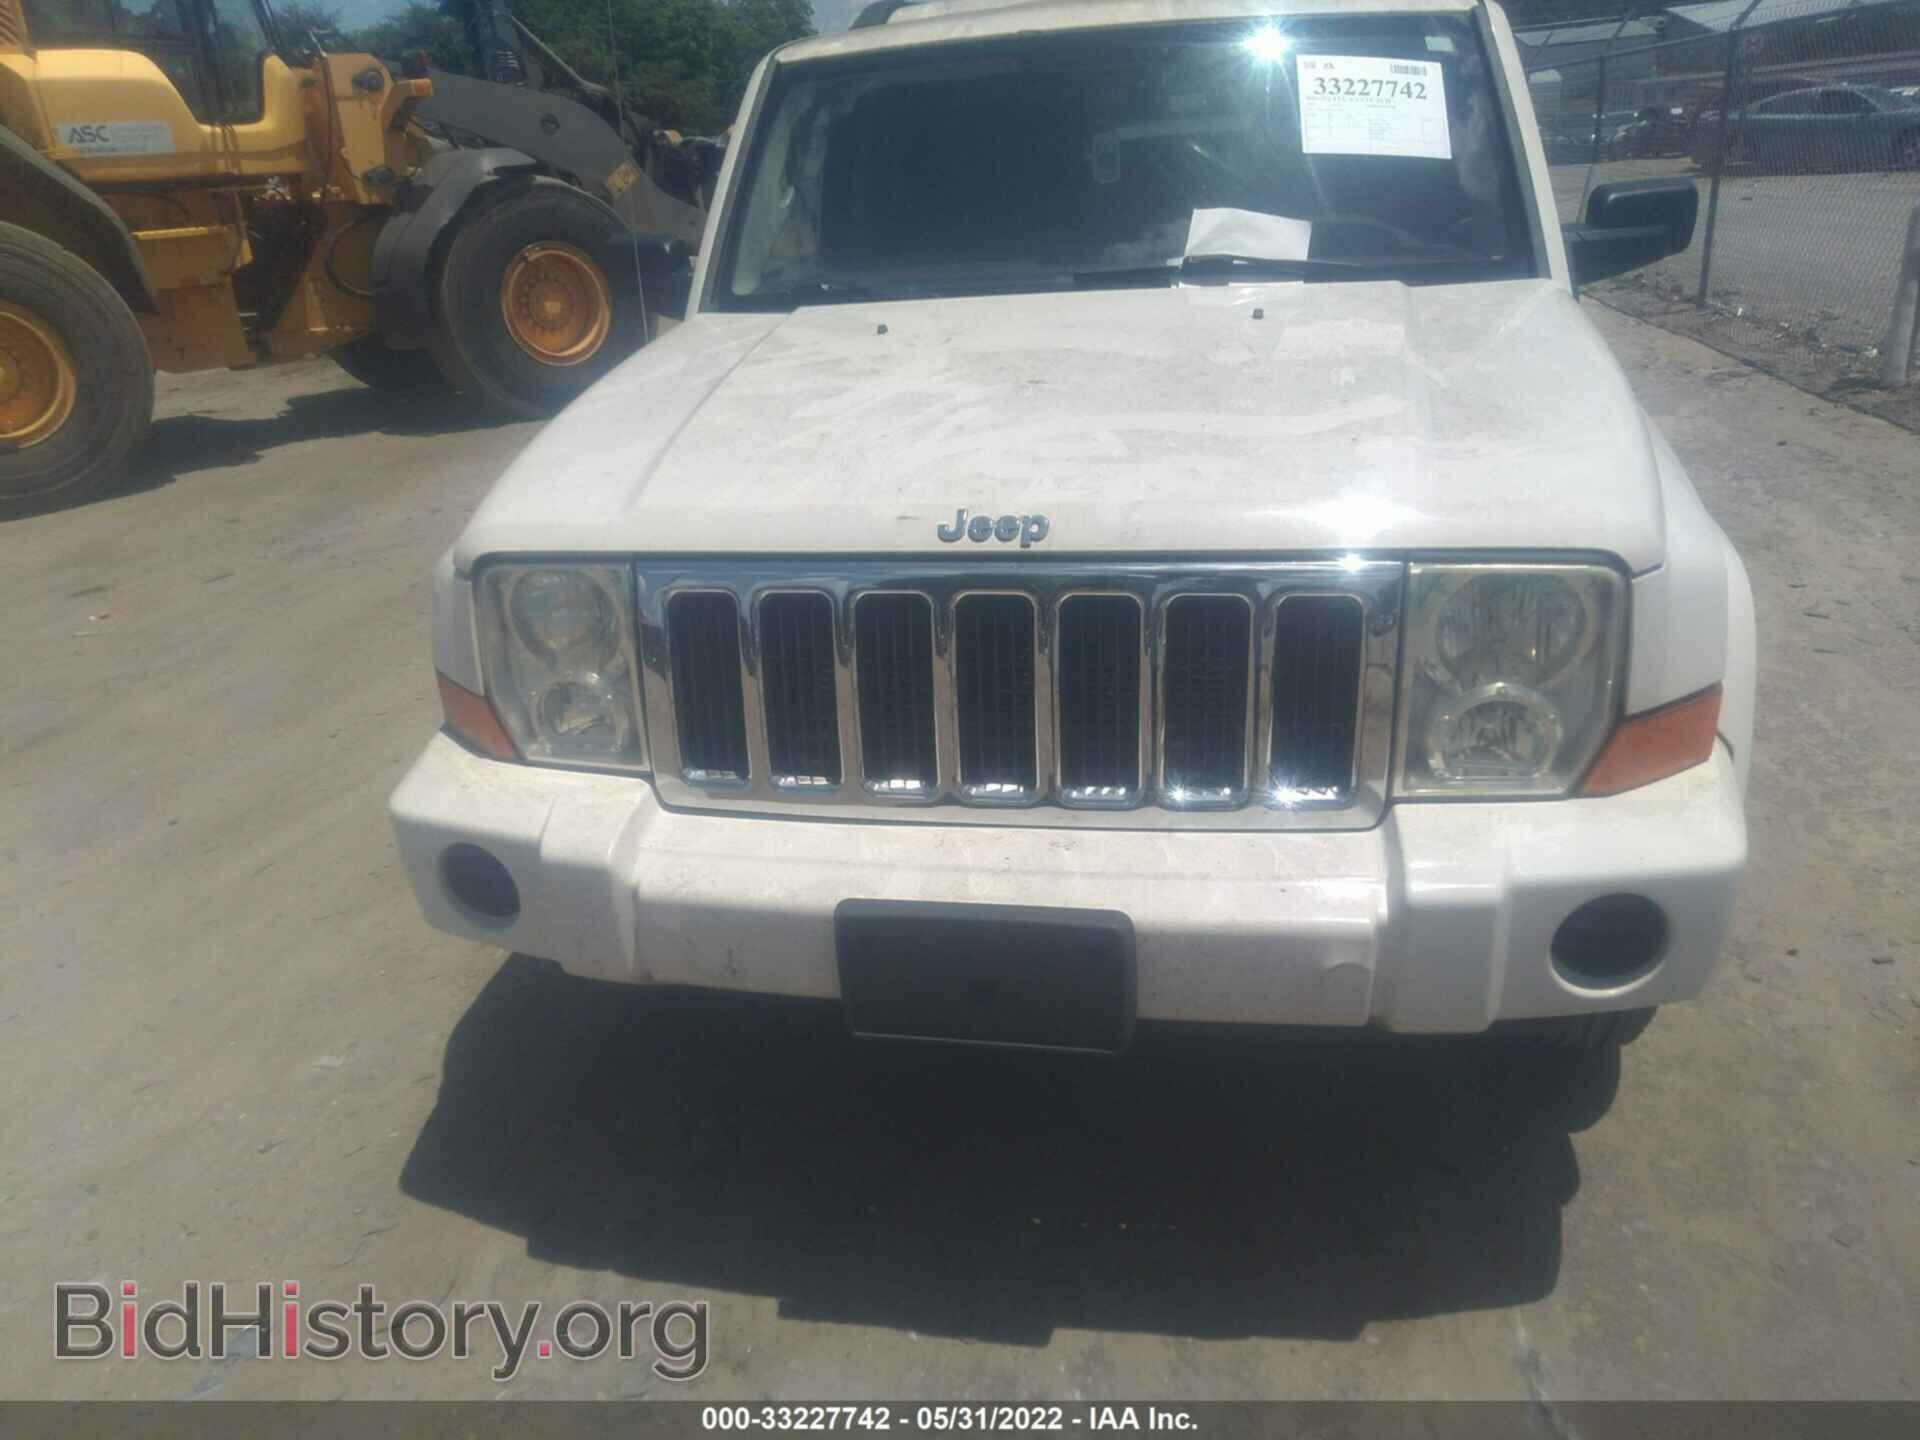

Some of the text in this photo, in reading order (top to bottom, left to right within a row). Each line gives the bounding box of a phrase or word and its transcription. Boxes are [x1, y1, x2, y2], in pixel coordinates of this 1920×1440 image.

[1313, 77, 1428, 100] 33227742
[69, 125, 110, 143] ASC
[937, 508, 1049, 548] Jeep
